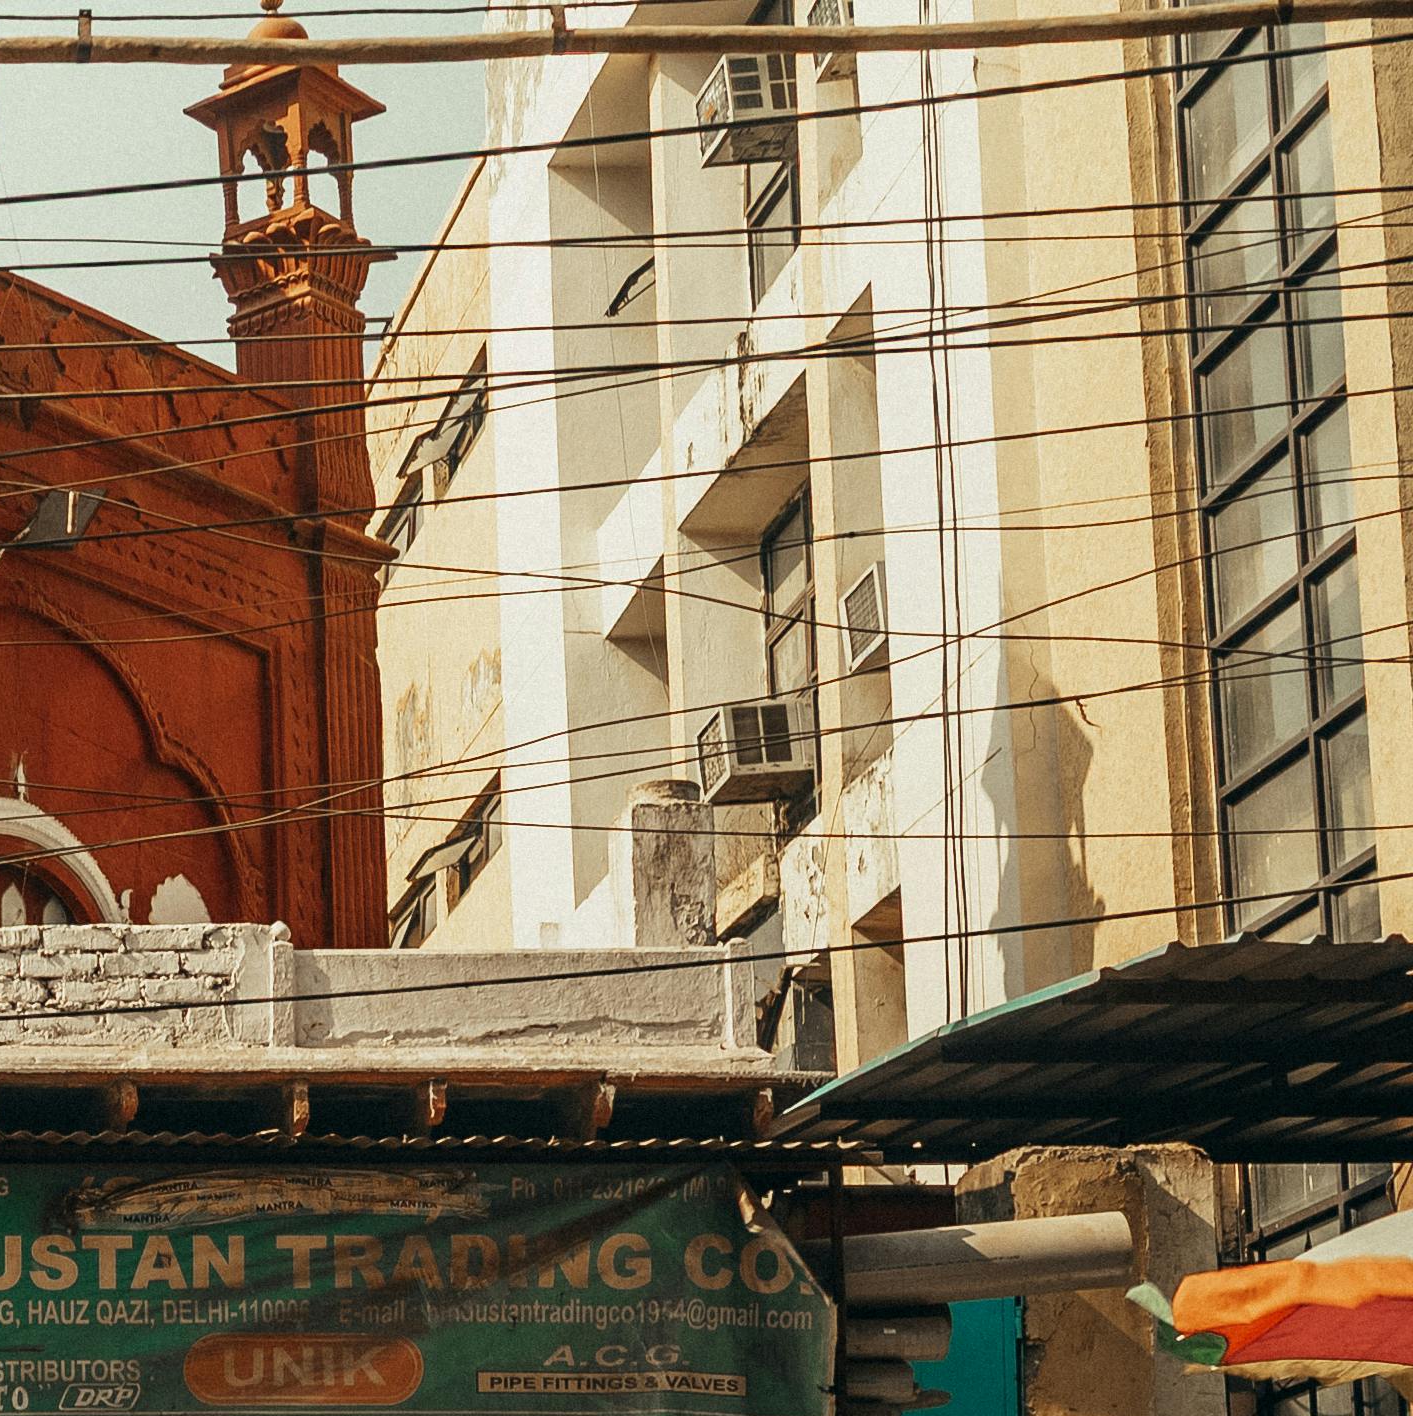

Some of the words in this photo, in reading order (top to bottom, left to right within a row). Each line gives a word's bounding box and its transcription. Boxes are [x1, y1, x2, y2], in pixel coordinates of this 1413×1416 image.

[511, 1176, 536, 1199] Ph
[122, 1213, 171, 1224] MANTRA
[255, 1200, 304, 1213] MANTRA
[276, 1232, 653, 1291] TRADING
[684, 1232, 816, 1297] CO.
[27, 1300, 90, 1326] HAUZ
[95, 1300, 156, 1330] QAZI,
[339, 1298, 406, 1325] E-mail
[223, 1343, 388, 1388] UNIK
[543, 1343, 691, 1368] A.C.G.
[489, 1376, 536, 1392] PIPE
[542, 1376, 638, 1392] FITTINGS
[643, 1377, 657, 1392] &
[665, 1377, 739, 1393] VALVES
[74, 1385, 135, 1409] DRP
